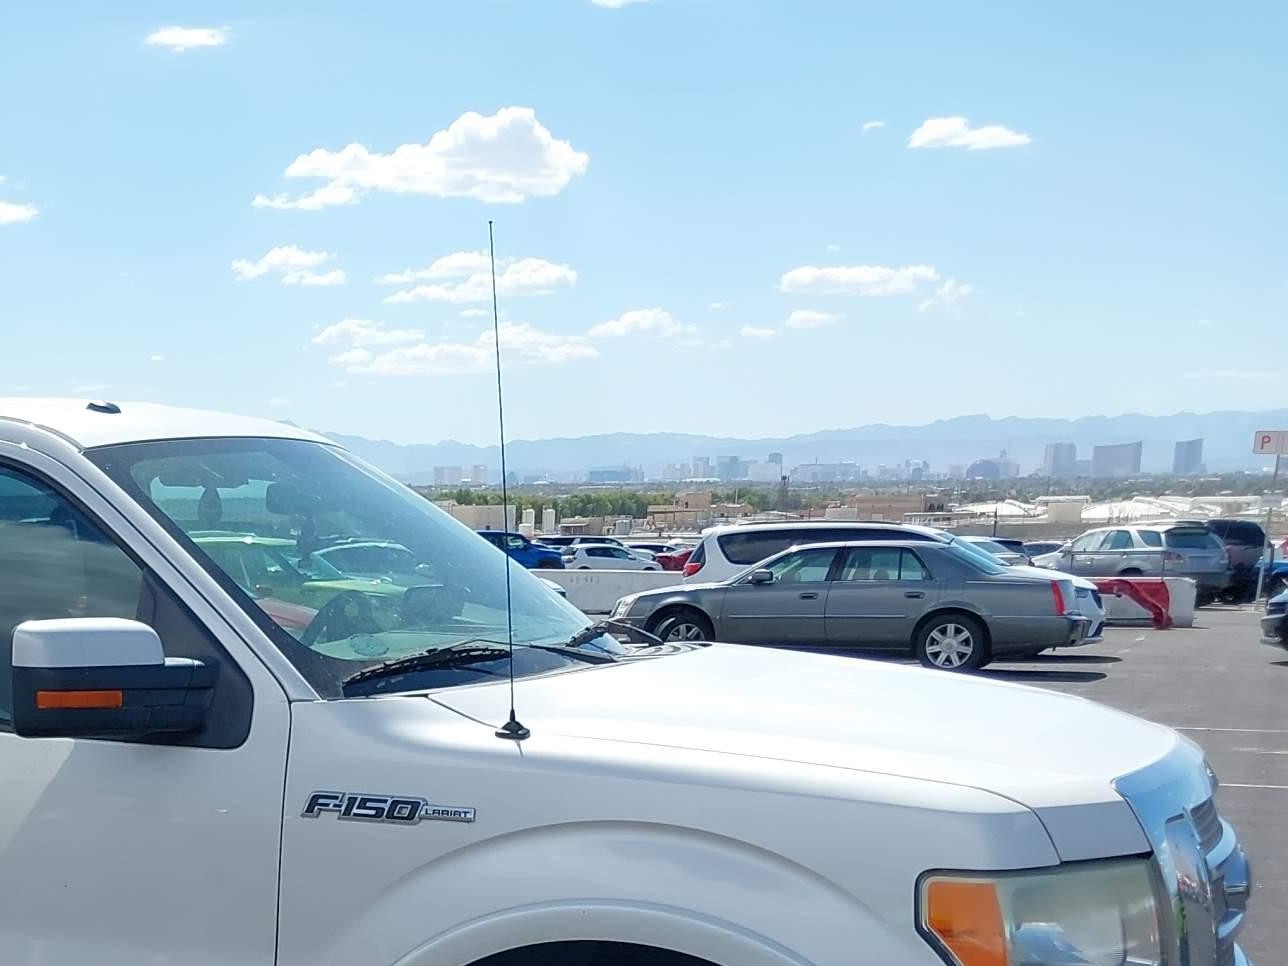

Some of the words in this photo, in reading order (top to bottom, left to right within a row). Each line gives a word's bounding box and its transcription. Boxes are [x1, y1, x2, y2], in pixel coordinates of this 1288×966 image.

[1260, 435, 1272, 450] P
[303, 792, 424, 824] F-150
[424, 807, 471, 818] LARIAT
